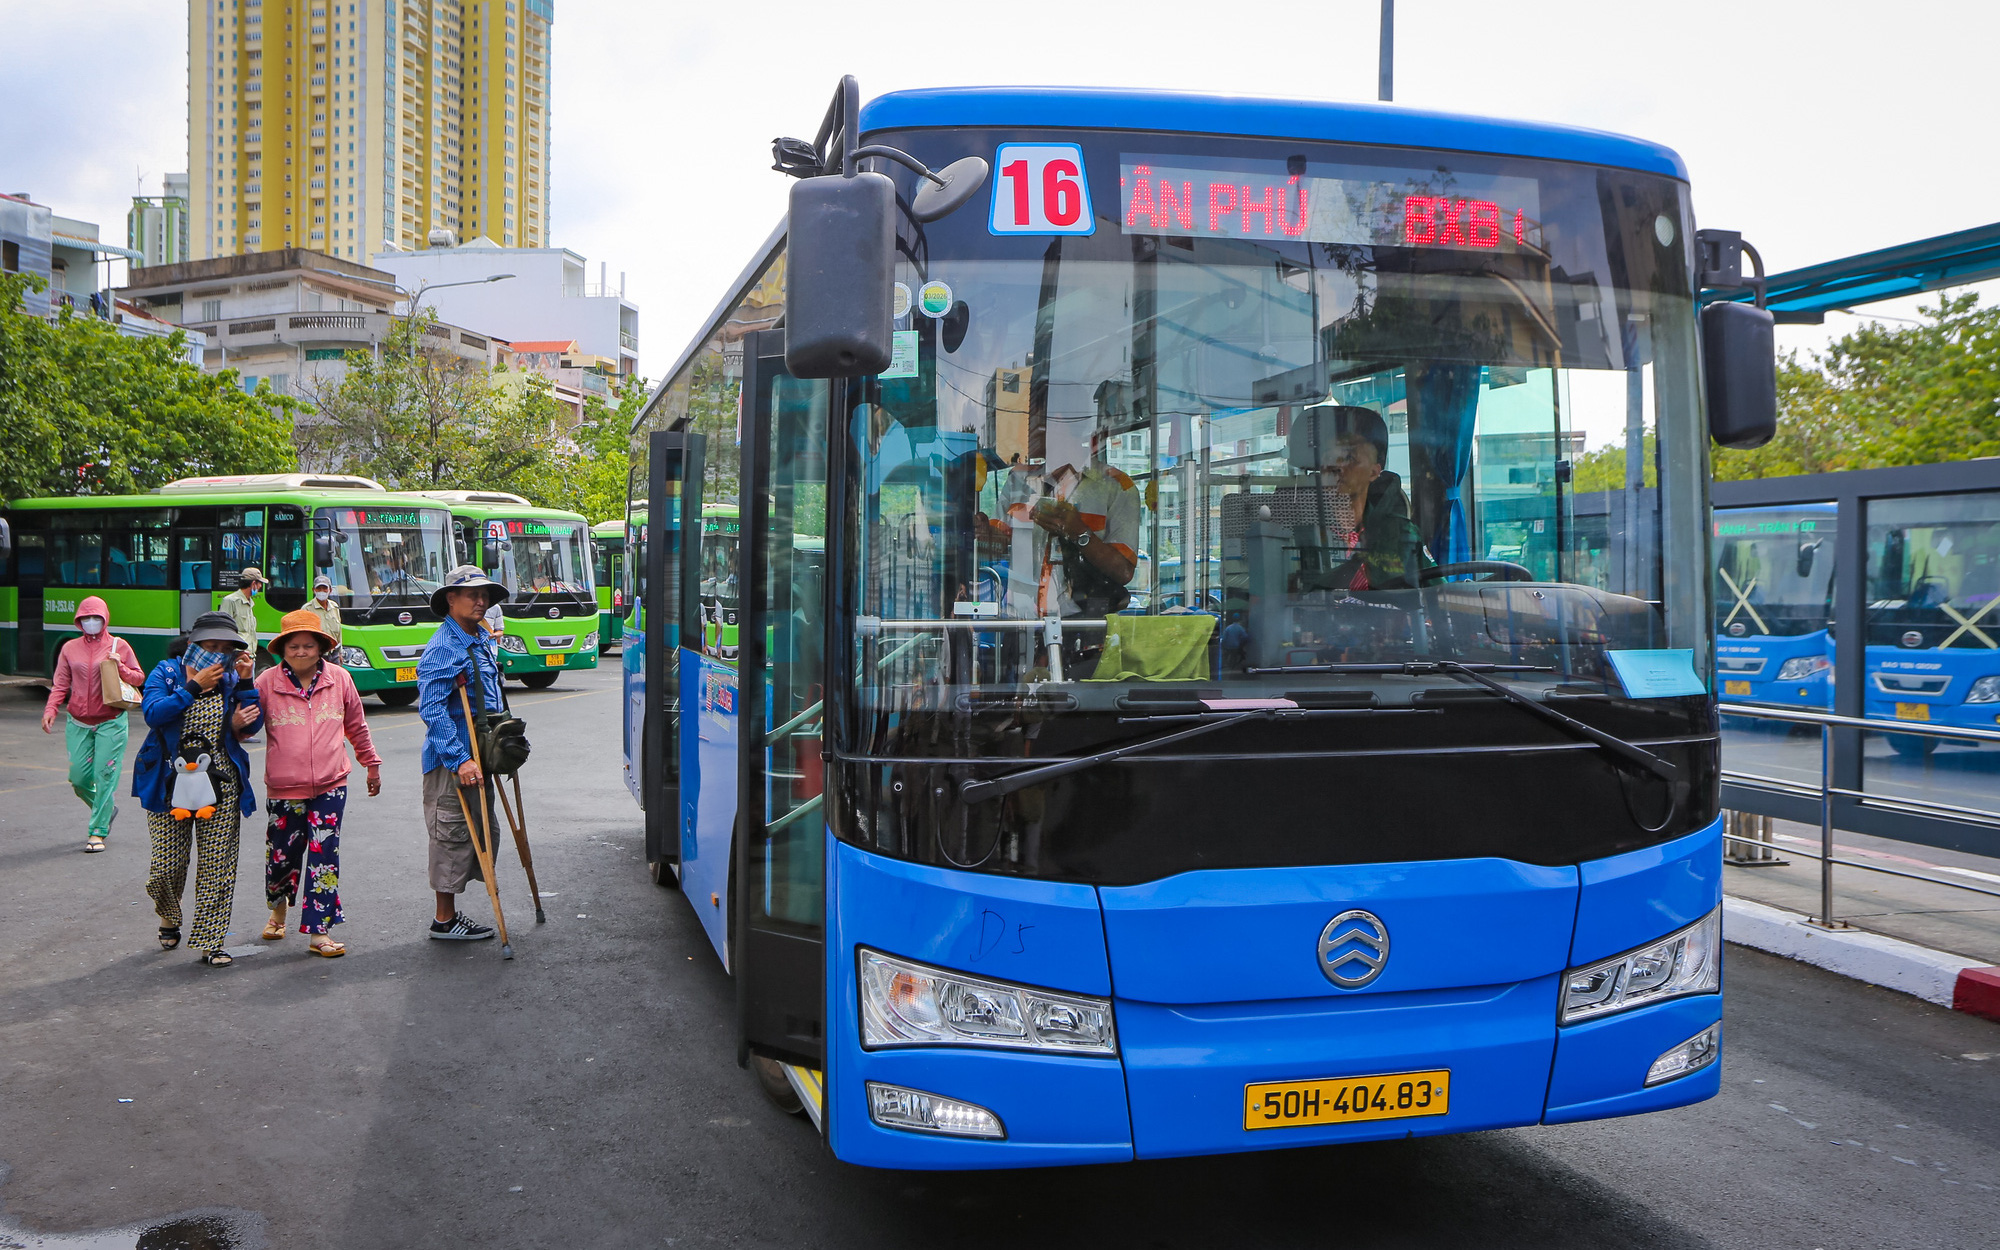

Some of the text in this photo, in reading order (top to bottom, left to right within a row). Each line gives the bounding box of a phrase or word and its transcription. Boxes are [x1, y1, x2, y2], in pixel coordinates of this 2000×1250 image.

[1002, 159, 1082, 226] 16
[1120, 165, 1193, 230] ÂN
[1209, 176, 1308, 236] PHÚ
[489, 523, 504, 537] 81
[533, 525, 551, 535] MINH
[1264, 1080, 1432, 1120] 50H-404.83
